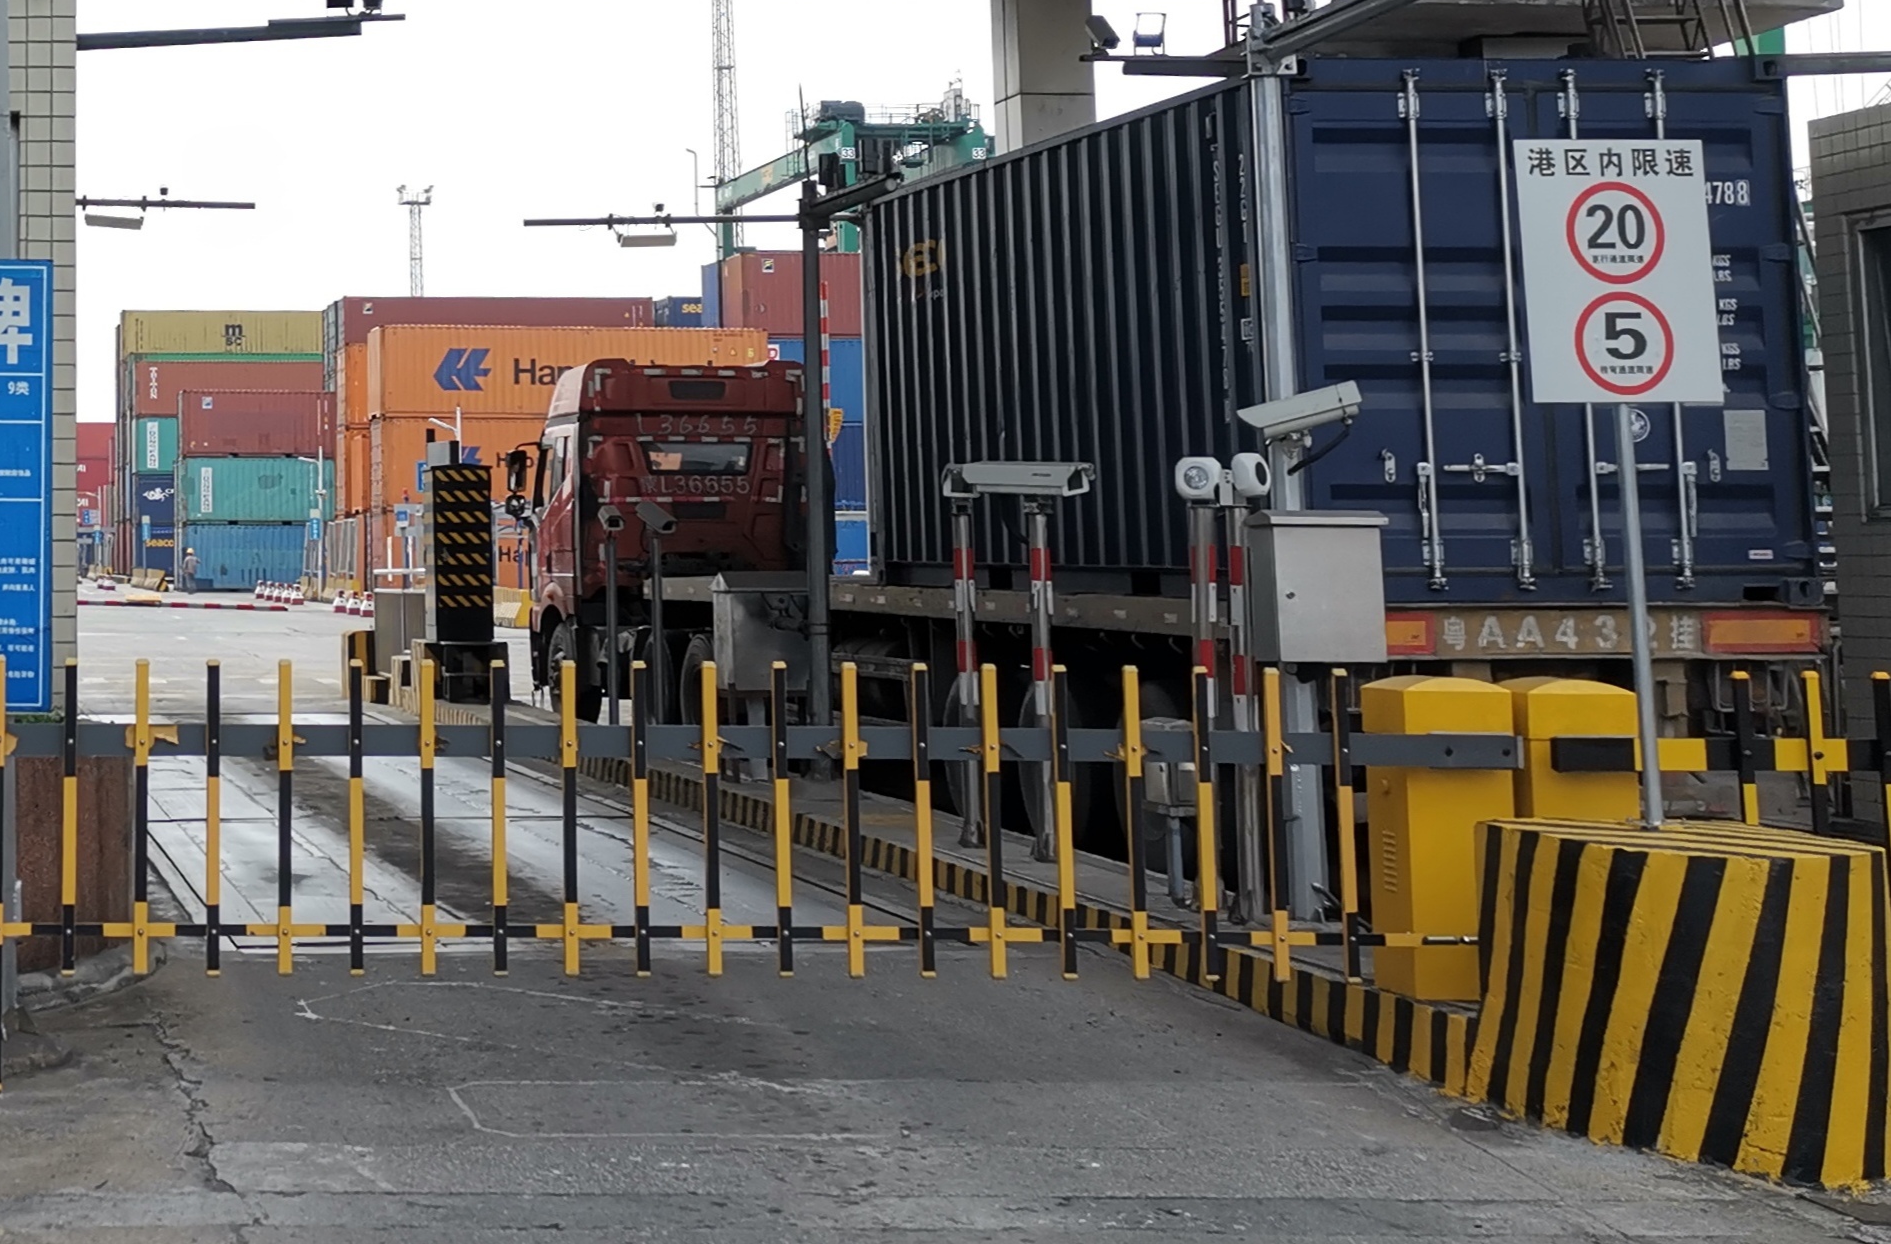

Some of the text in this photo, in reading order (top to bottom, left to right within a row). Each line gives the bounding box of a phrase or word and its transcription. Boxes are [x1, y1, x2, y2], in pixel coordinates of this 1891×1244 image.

[841, 147, 855, 159] 33
[972, 147, 986, 159] 33
[1526, 147, 1694, 178] 港区内限速
[1584, 202, 1646, 251] 20
[1718, 298, 1738, 311] KGS
[1604, 312, 1648, 360] 5
[1722, 358, 1742, 370] LBS
